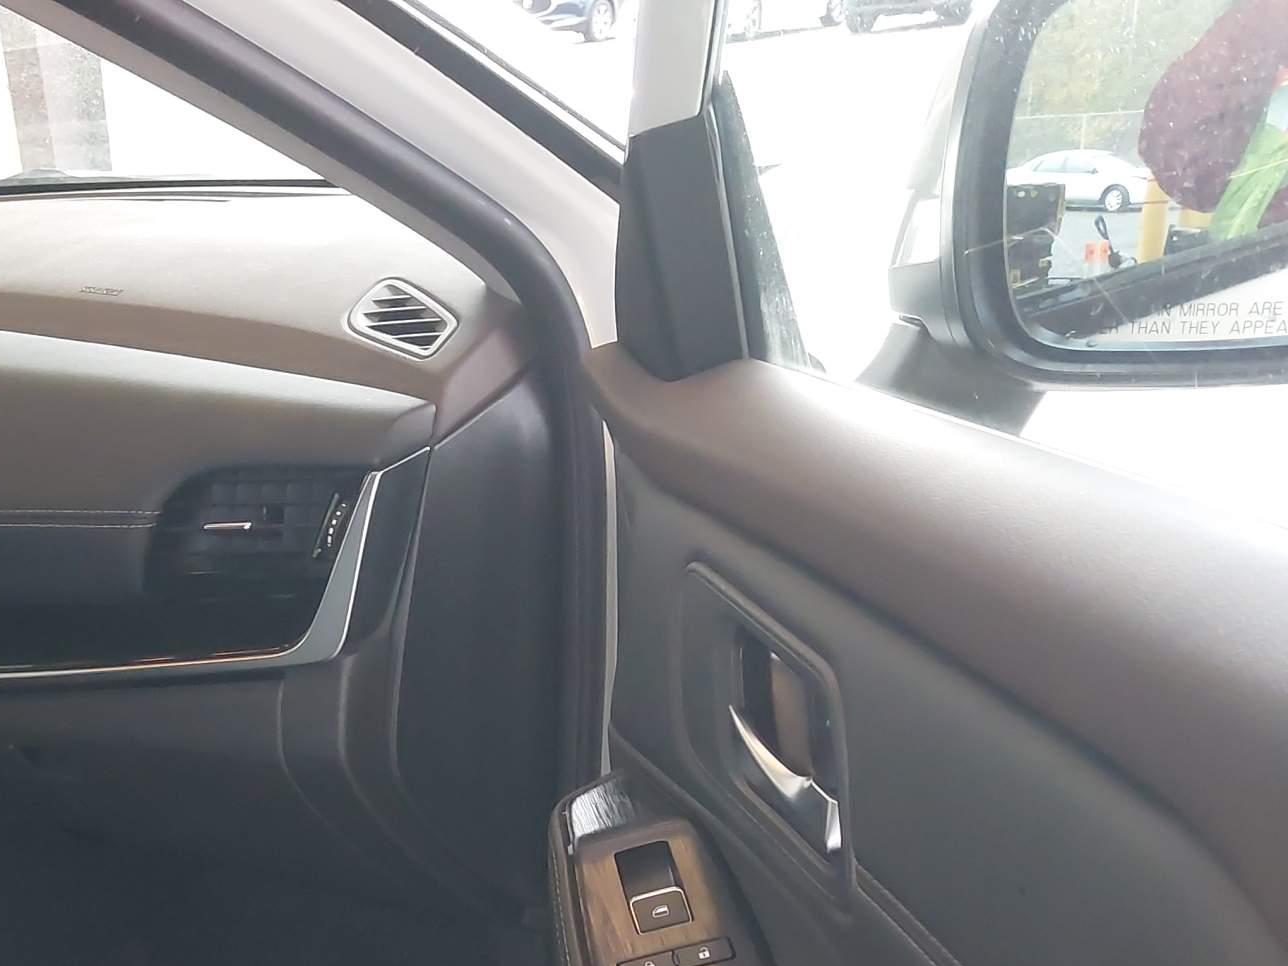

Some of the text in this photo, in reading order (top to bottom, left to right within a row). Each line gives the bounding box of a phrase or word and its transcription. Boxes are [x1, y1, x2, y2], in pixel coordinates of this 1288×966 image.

[1178, 302, 1240, 317] MIRROR
[1247, 300, 1285, 316] ARE
[1128, 320, 1171, 335] THAN
[1179, 320, 1221, 335] THEY
